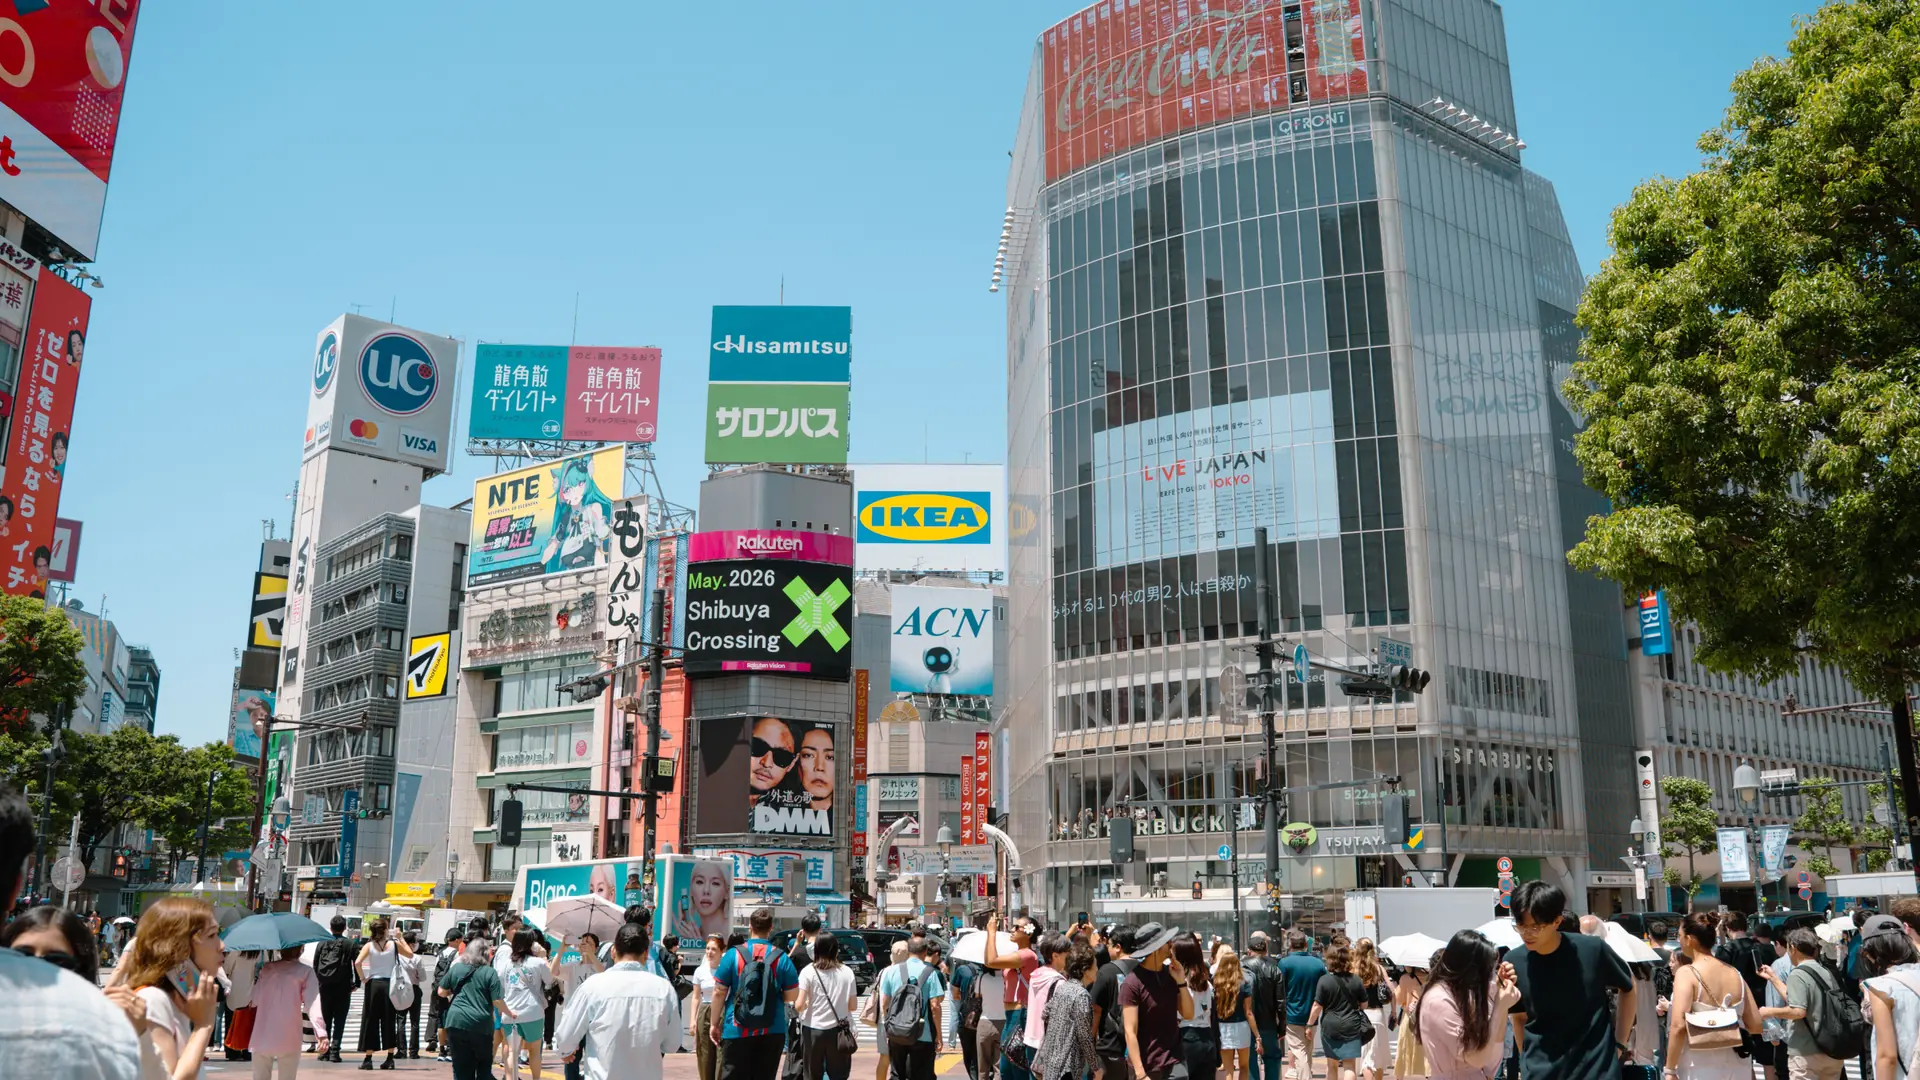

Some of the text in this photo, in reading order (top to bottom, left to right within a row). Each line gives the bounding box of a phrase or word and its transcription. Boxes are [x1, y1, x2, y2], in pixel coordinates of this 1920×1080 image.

[713, 335, 848, 354] Hisamitsu
[494, 364, 549, 388] 龍角散
[587, 366, 642, 390] 龍角散
[484, 389, 557, 412] ダイレクト
[578, 391, 650, 414] ダイレクト
[716, 406, 839, 438] サロンパス
[402, 433, 437, 453] VISA
[1195, 447, 1266, 474] JAPAN
[488, 474, 540, 510] NTE
[1209, 474, 1250, 489] TOKYO
[871, 506, 980, 527] IKEA
[737, 536, 803, 553] Rakuten
[608, 500, 643, 633] もんじゃ
[688, 569, 775, 591] May. 2026
[688, 600, 770, 621] Shibuya
[893, 605, 990, 638] ACN
[687, 630, 781, 653] Crossing
[287, 658, 297, 671] 7F
[427, 647, 446, 683] matsukiyo
[746, 662, 786, 670] Rakuten Vision
[977, 740, 989, 797] カラオケ
[880, 790, 918, 799] クリニック
[890, 780, 918, 788] れいわ
[770, 788, 814, 804] 外道の歌
[754, 806, 831, 835] DMM
[962, 801, 972, 845] カラオ
[1088, 814, 1243, 840] STRBUCK
[1238, 862, 1268, 874] STA
